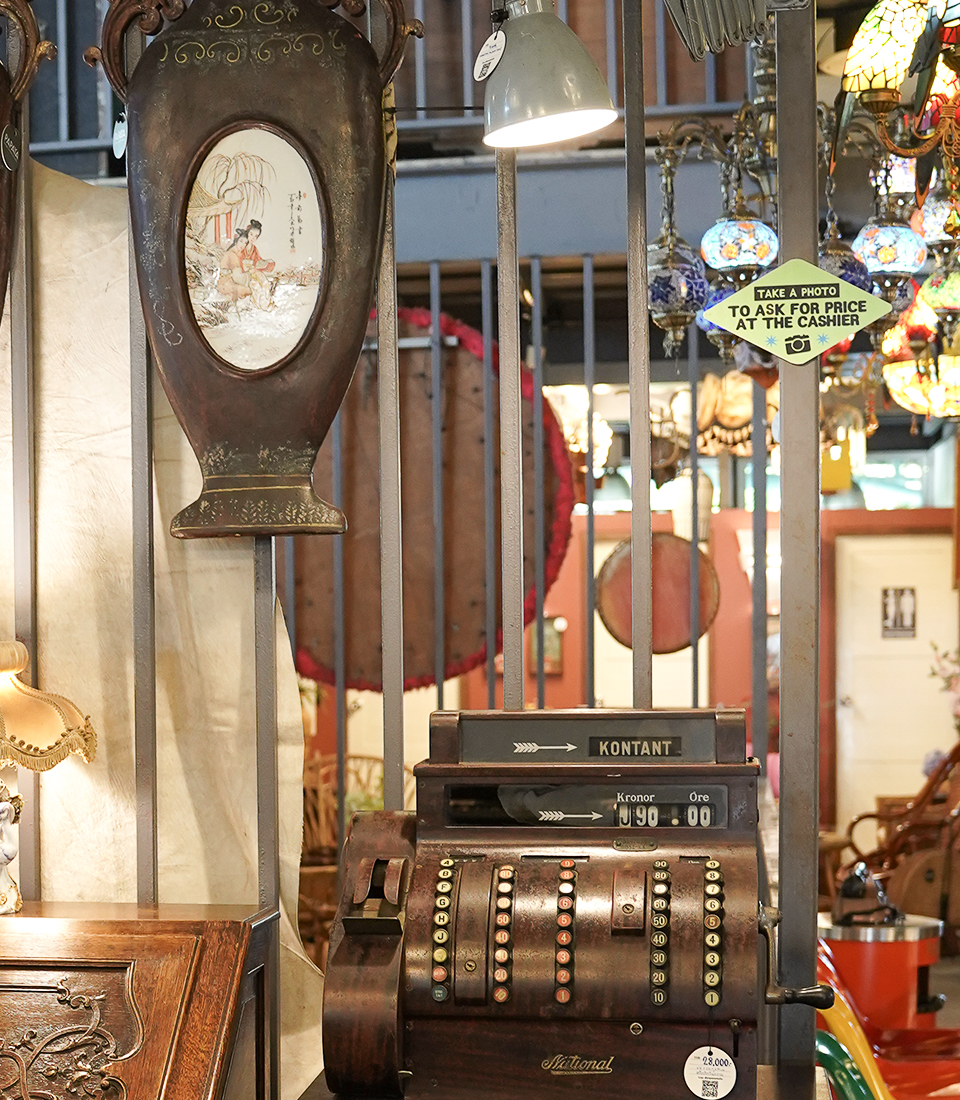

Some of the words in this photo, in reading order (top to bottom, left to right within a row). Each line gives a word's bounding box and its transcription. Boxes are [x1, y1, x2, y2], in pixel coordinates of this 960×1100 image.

[757, 288, 785, 298] TAKE
[790, 288, 797, 298] A
[801, 286, 836, 296] PHOTO
[728, 305, 750, 318] TO
[755, 303, 785, 316] ASK
[790, 302, 820, 315] FOR
[825, 300, 867, 313] PRICE
[736, 318, 758, 330] AT
[762, 316, 793, 329] THE
[798, 314, 860, 328] CASHIER
[599, 740, 672, 756] KONTANT
[616, 792, 656, 802] Kronor
[687, 804, 711, 828] 00
[653, 899, 666, 907] 60
[497, 916, 508, 924] 50
[653, 916, 666, 926] 50
[496, 933, 508, 941] 40
[652, 934, 665, 943] 40
[653, 954, 665, 963] 30
[495, 971, 507, 980] 20
[652, 973, 665, 982] 20
[653, 992, 664, 1002] 10
[541, 1054, 614, 1074] National
